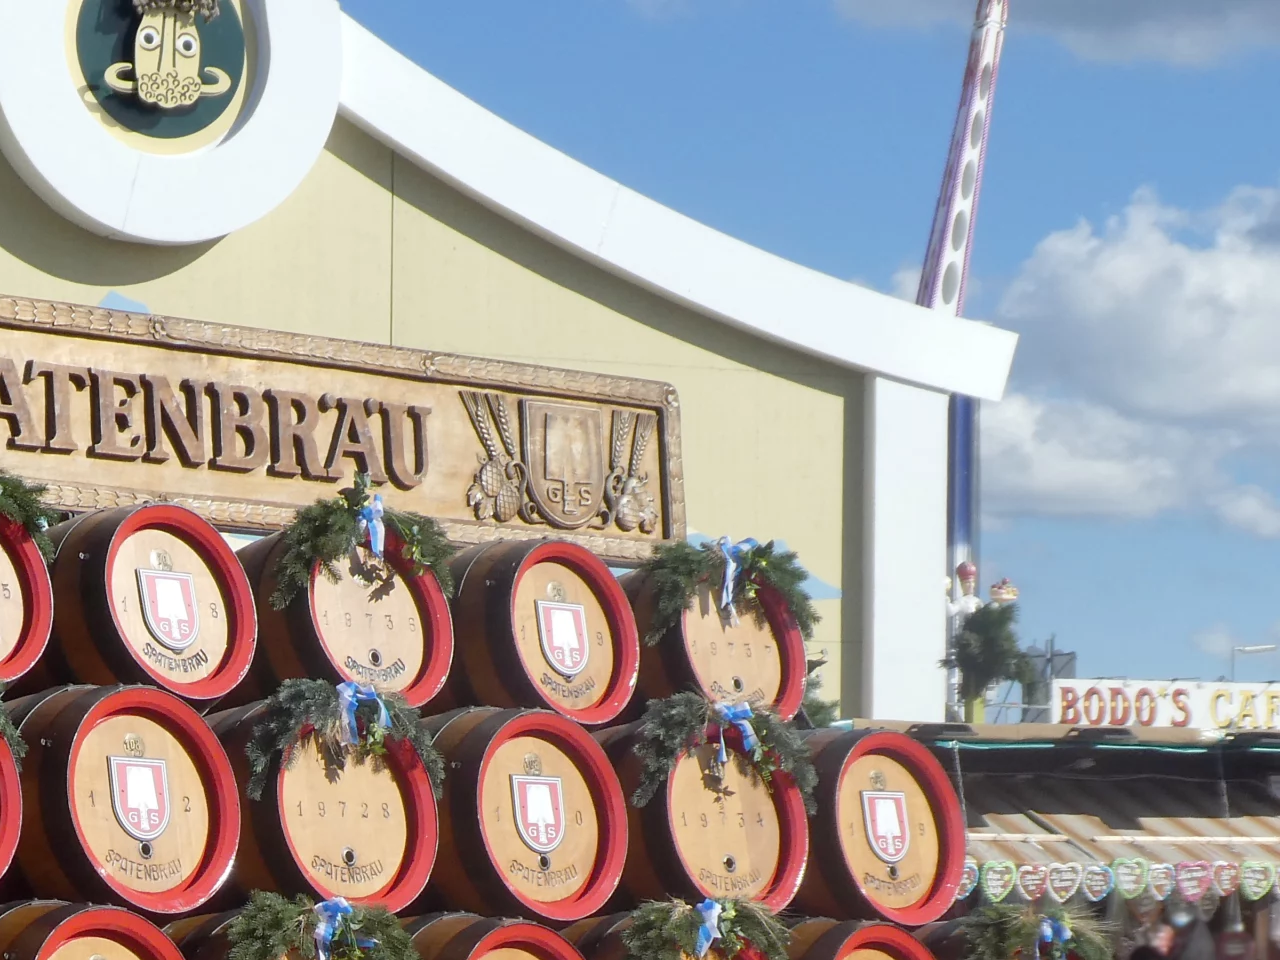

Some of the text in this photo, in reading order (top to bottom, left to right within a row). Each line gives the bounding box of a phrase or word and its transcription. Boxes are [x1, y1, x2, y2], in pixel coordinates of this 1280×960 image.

[547, 485, 593, 506] G S
[160, 620, 190, 635] G S
[554, 651, 581, 662] G S
[89, 790, 191, 813] 1 2
[129, 811, 159, 824] G S
[528, 825, 557, 838] G S
[878, 838, 903, 849] G S
[105, 849, 182, 881] SPATENBRÄU
[311, 855, 384, 884] SPATENBRÄU
